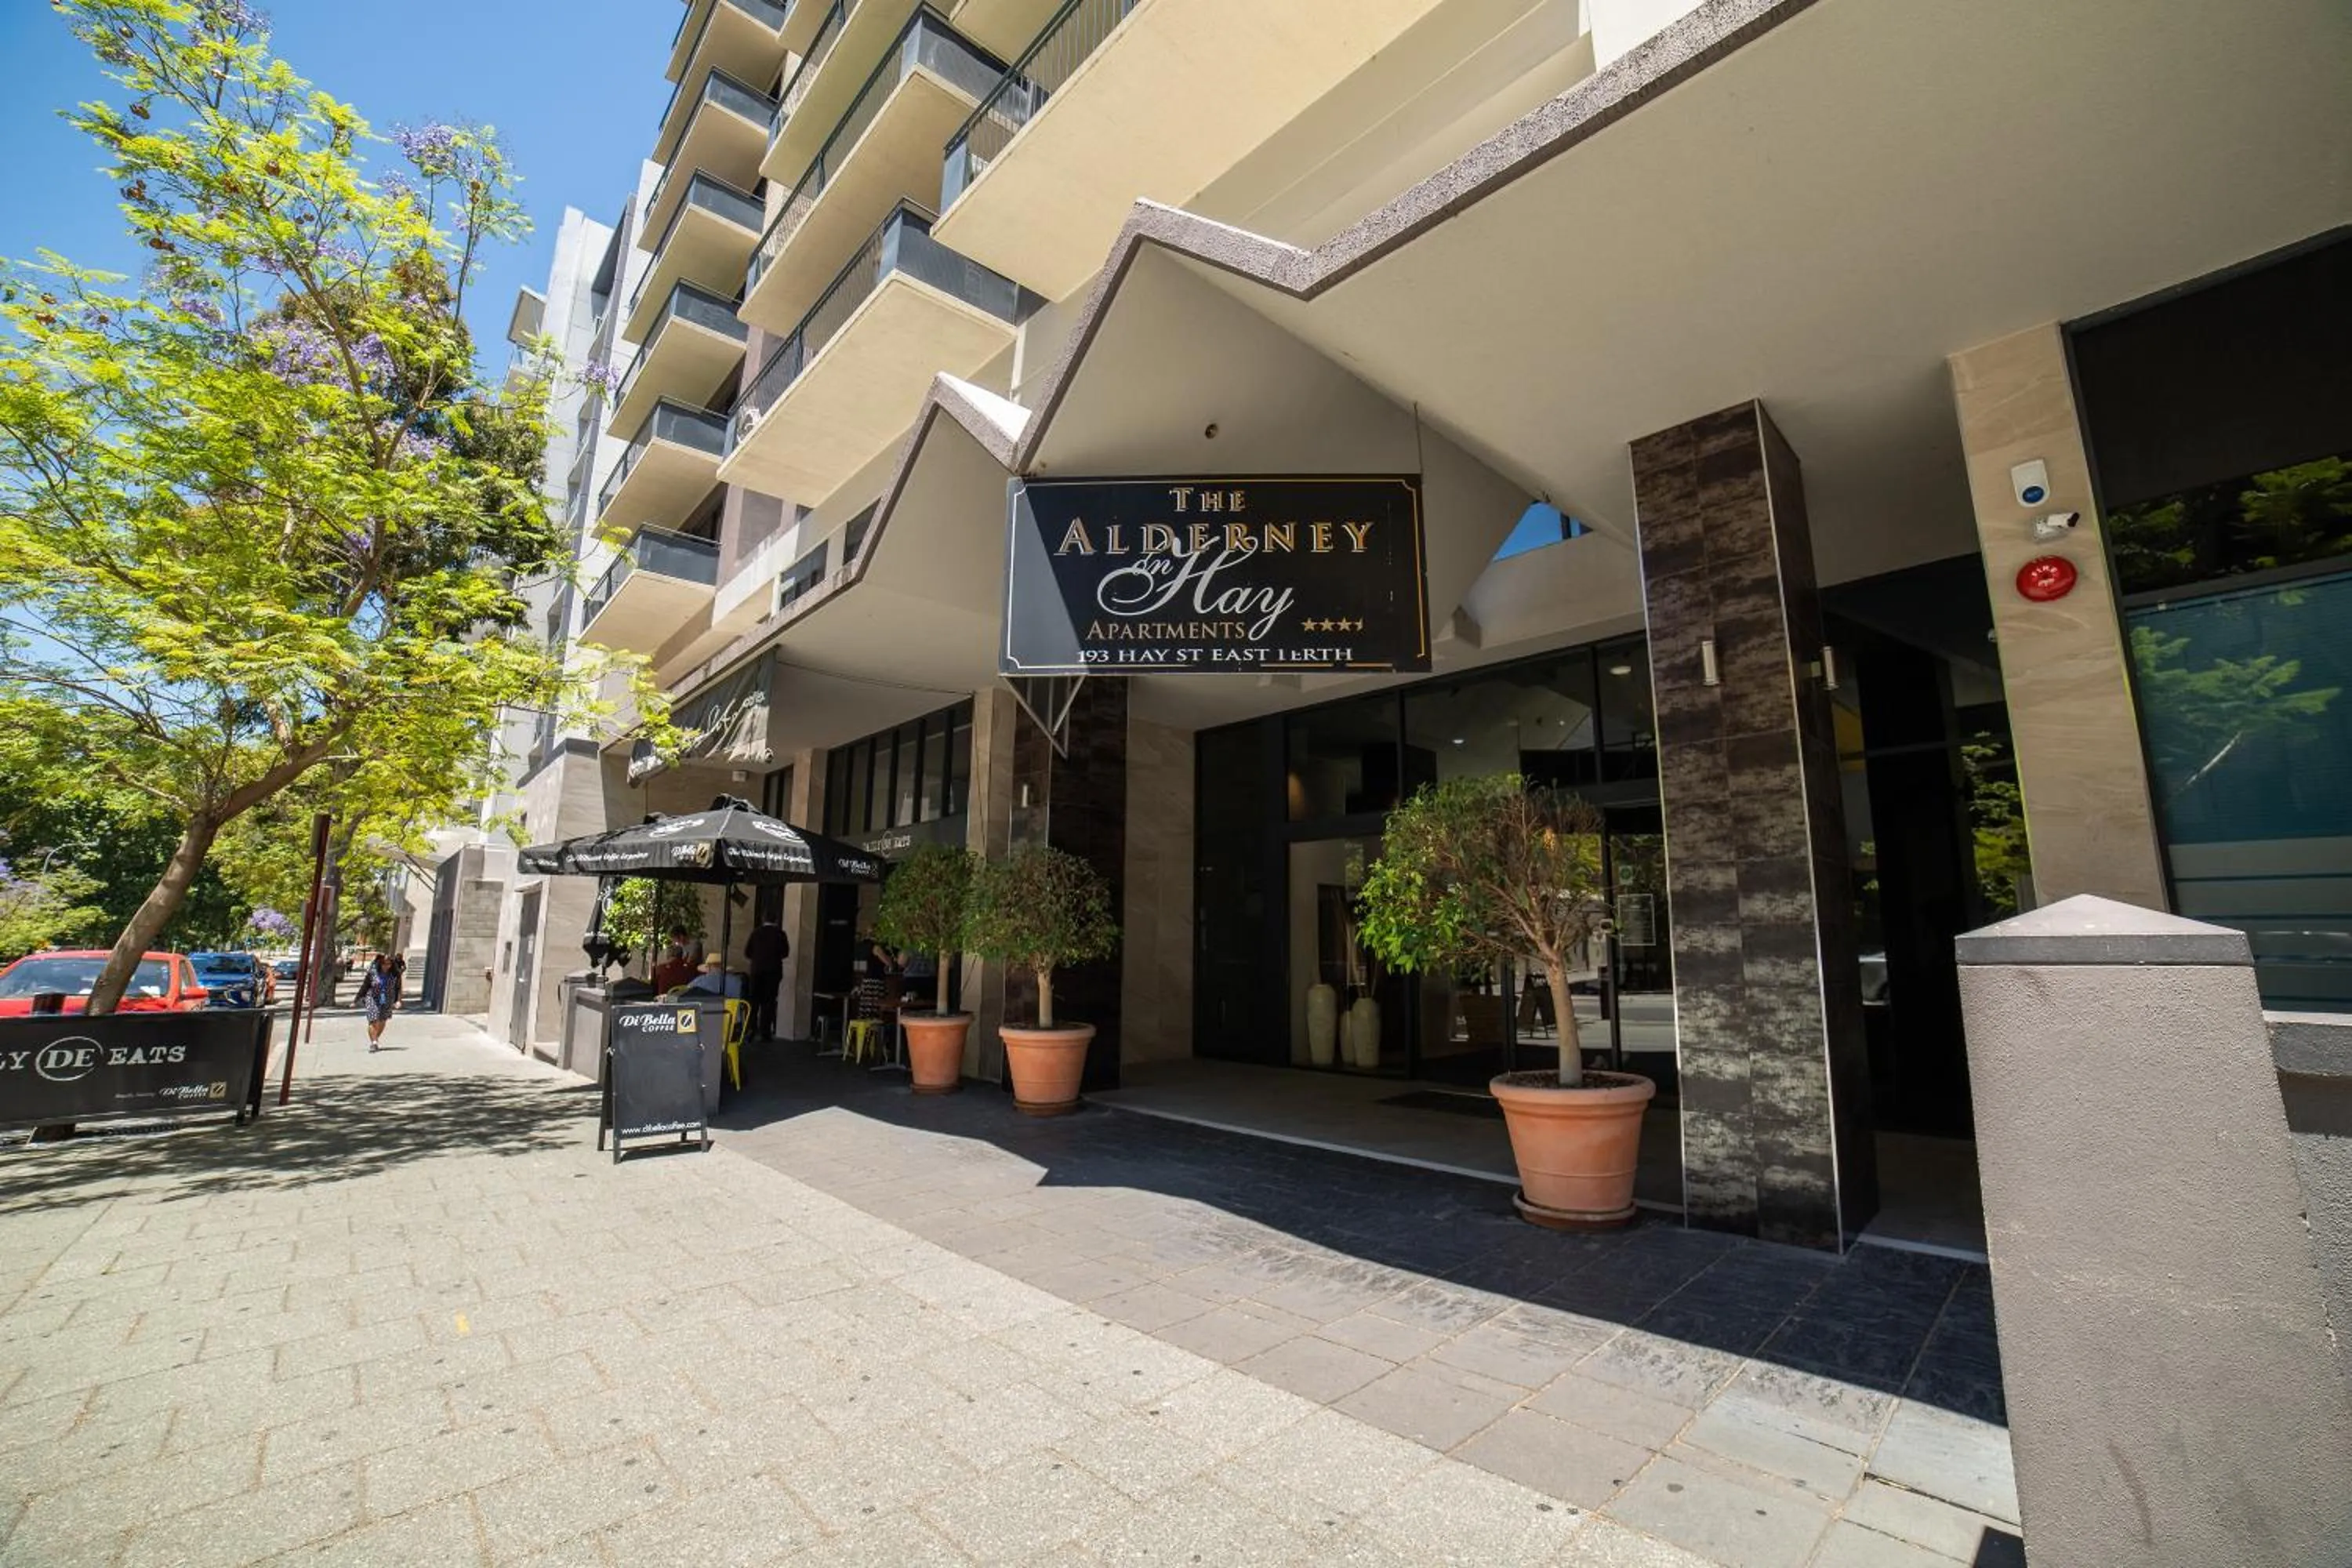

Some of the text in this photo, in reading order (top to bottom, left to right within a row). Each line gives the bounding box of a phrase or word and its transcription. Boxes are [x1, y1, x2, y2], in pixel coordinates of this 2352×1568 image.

[1169, 487, 1246, 512] THE
[1054, 516, 1374, 556] ALDERNEY
[1098, 535, 1294, 641] Hay
[1086, 619, 1246, 641] APARTMENTS
[1078, 649, 1110, 663] 193
[1118, 648, 1170, 662] HAY
[1176, 648, 1204, 662] ST
[1211, 648, 1270, 662] EAST
[44, 1048, 95, 1069] DE
[107, 1045, 187, 1065] EATS
